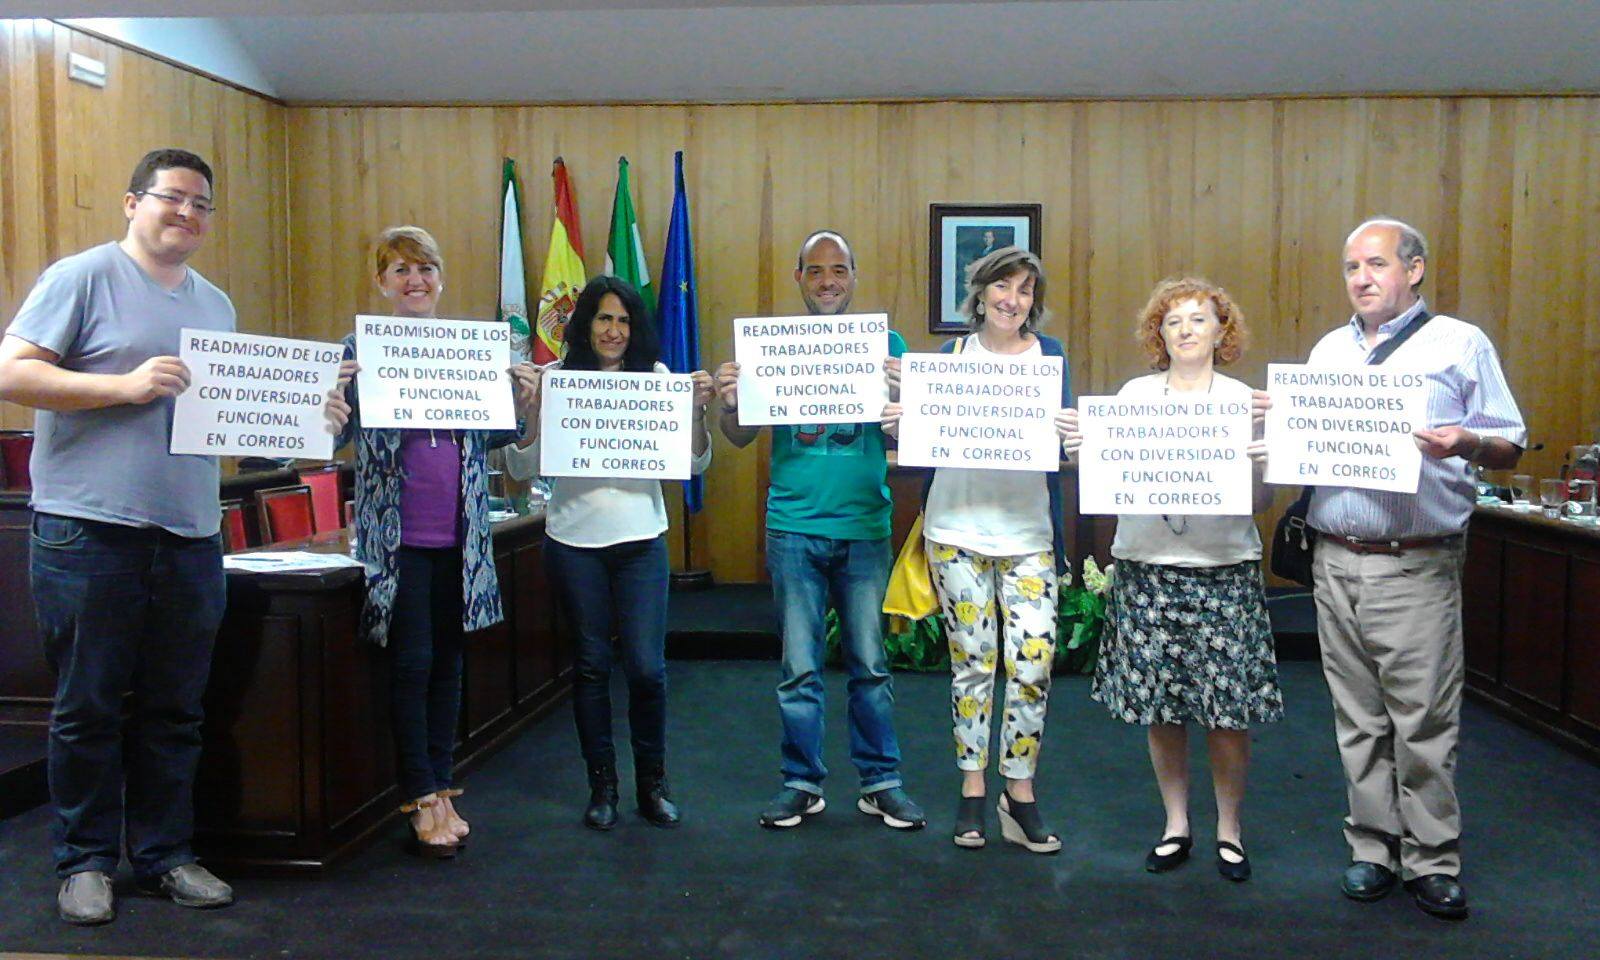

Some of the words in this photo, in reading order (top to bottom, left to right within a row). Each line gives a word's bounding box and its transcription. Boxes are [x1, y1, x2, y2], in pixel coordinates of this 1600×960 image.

[365, 324, 456, 339] READMISION
[462, 328, 480, 340] DE
[484, 329, 508, 341] LOS
[743, 323, 832, 337] READMISION
[838, 322, 855, 333] DE
[860, 321, 885, 333] LOS
[191, 338, 287, 359] READMISION
[292, 348, 310, 360] DE
[315, 349, 340, 363] LOS
[383, 346, 491, 361] TRABAJADORES
[760, 343, 868, 356] TRABAJADORES
[209, 363, 319, 383] TRABAJADORES
[378, 367, 409, 379] CON
[414, 369, 498, 381] DIVERSIDAD
[756, 365, 785, 377] CON
[791, 362, 874, 376] DIVERSIDAD
[910, 361, 1004, 376] READMISION
[1009, 363, 1027, 376] DE
[1033, 364, 1059, 377] LOS
[551, 377, 639, 392] READMISION
[645, 380, 662, 392] DE
[667, 381, 691, 392] LOS
[1275, 372, 1364, 387] READMISION
[1369, 374, 1388, 387] DE
[1394, 374, 1422, 387] LOS
[200, 387, 232, 400] CON
[237, 390, 321, 406] DIVERSIDAD
[400, 388, 481, 401] FUNCIONAL
[776, 384, 856, 396] FUNCIONAL
[927, 383, 1040, 398] TRABAJADORES
[567, 398, 673, 412] TRABAJADORES
[770, 405, 788, 417] EN
[800, 403, 864, 416] CORREOS
[1088, 403, 1188, 417] READMISION
[1195, 404, 1213, 415] DE
[1220, 403, 1248, 415] LOS
[1291, 395, 1403, 410] TRABAJADORES
[394, 408, 412, 420] EN
[425, 408, 490, 421] CORREOS
[921, 404, 952, 416] CON
[957, 405, 1045, 419] DIVERSIDAD
[218, 412, 299, 427] FUNCIONAL
[561, 418, 591, 429] CON
[596, 418, 678, 432] DIVERSIDAD
[1288, 417, 1318, 430] CON
[1322, 419, 1412, 434] DIVERSIDAD
[940, 426, 1024, 439] FUNCIONAL
[1108, 426, 1229, 439] TRABAJADORES
[207, 433, 226, 446] EN
[238, 434, 305, 449] CORREOS
[580, 438, 659, 451] FUNCIONAL
[932, 447, 950, 458] EN
[963, 448, 1031, 462] CORREOS
[1101, 449, 1134, 461] CON
[1140, 448, 1235, 461] DIVERSIDAD
[1308, 442, 1391, 456] FUNCIONAL
[572, 458, 590, 469] EN
[602, 458, 666, 471] CORREOS
[1300, 463, 1318, 475] EN
[1332, 464, 1396, 480] CORREOS
[1123, 471, 1214, 483] FUNCIONAL
[1115, 493, 1134, 505] EN
[1149, 493, 1222, 505] CORREOS
